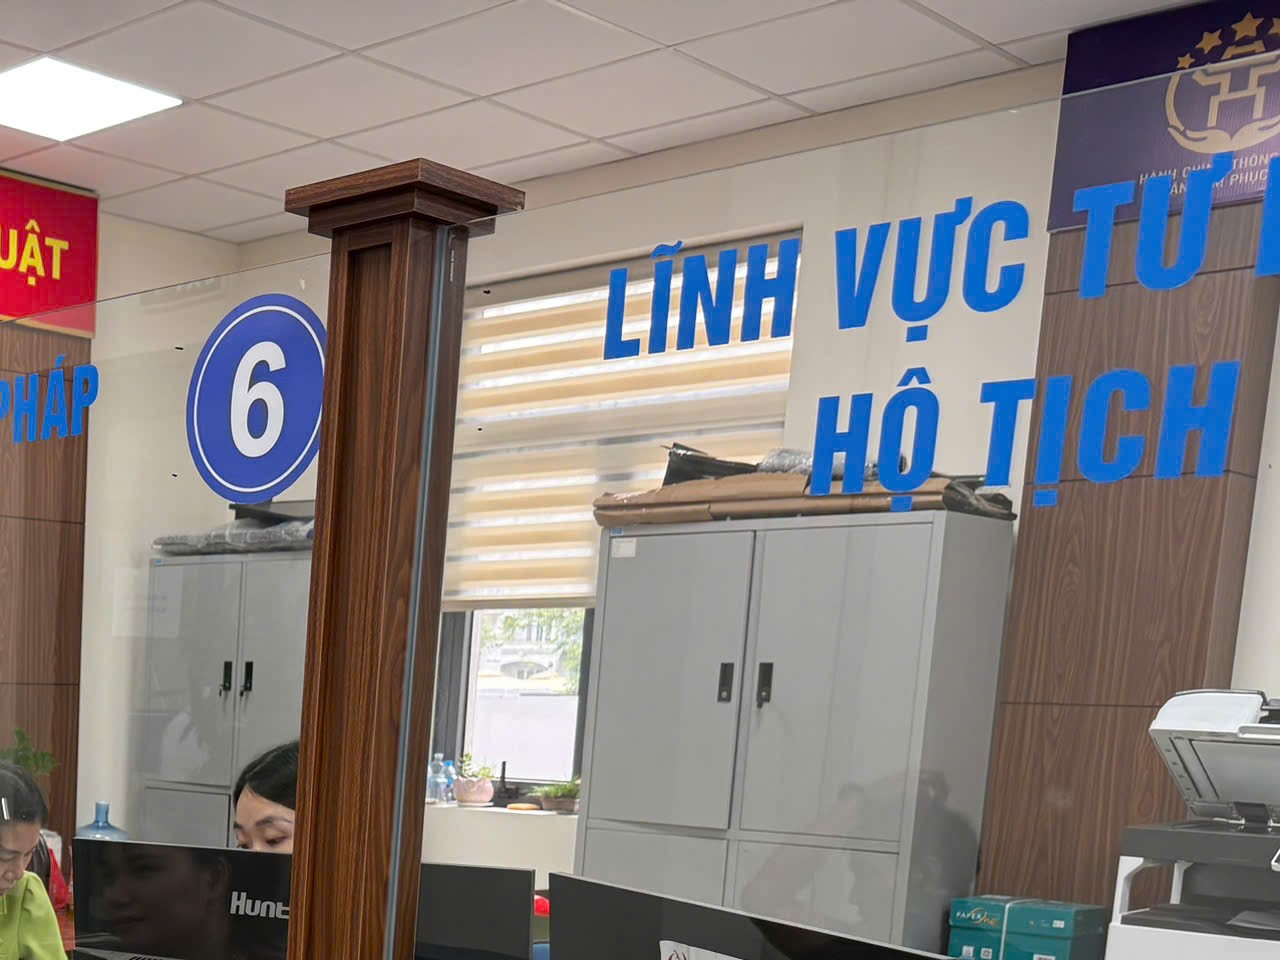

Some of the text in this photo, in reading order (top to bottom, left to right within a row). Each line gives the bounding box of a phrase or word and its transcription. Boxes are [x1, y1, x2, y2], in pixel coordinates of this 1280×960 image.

[603, 240, 800, 360] LĨNH
[835, 196, 1030, 343] VỰC
[1072, 151, 1235, 300] TƯ
[229, 340, 287, 458] 6
[810, 360, 1241, 513] HỘ TỊCH
